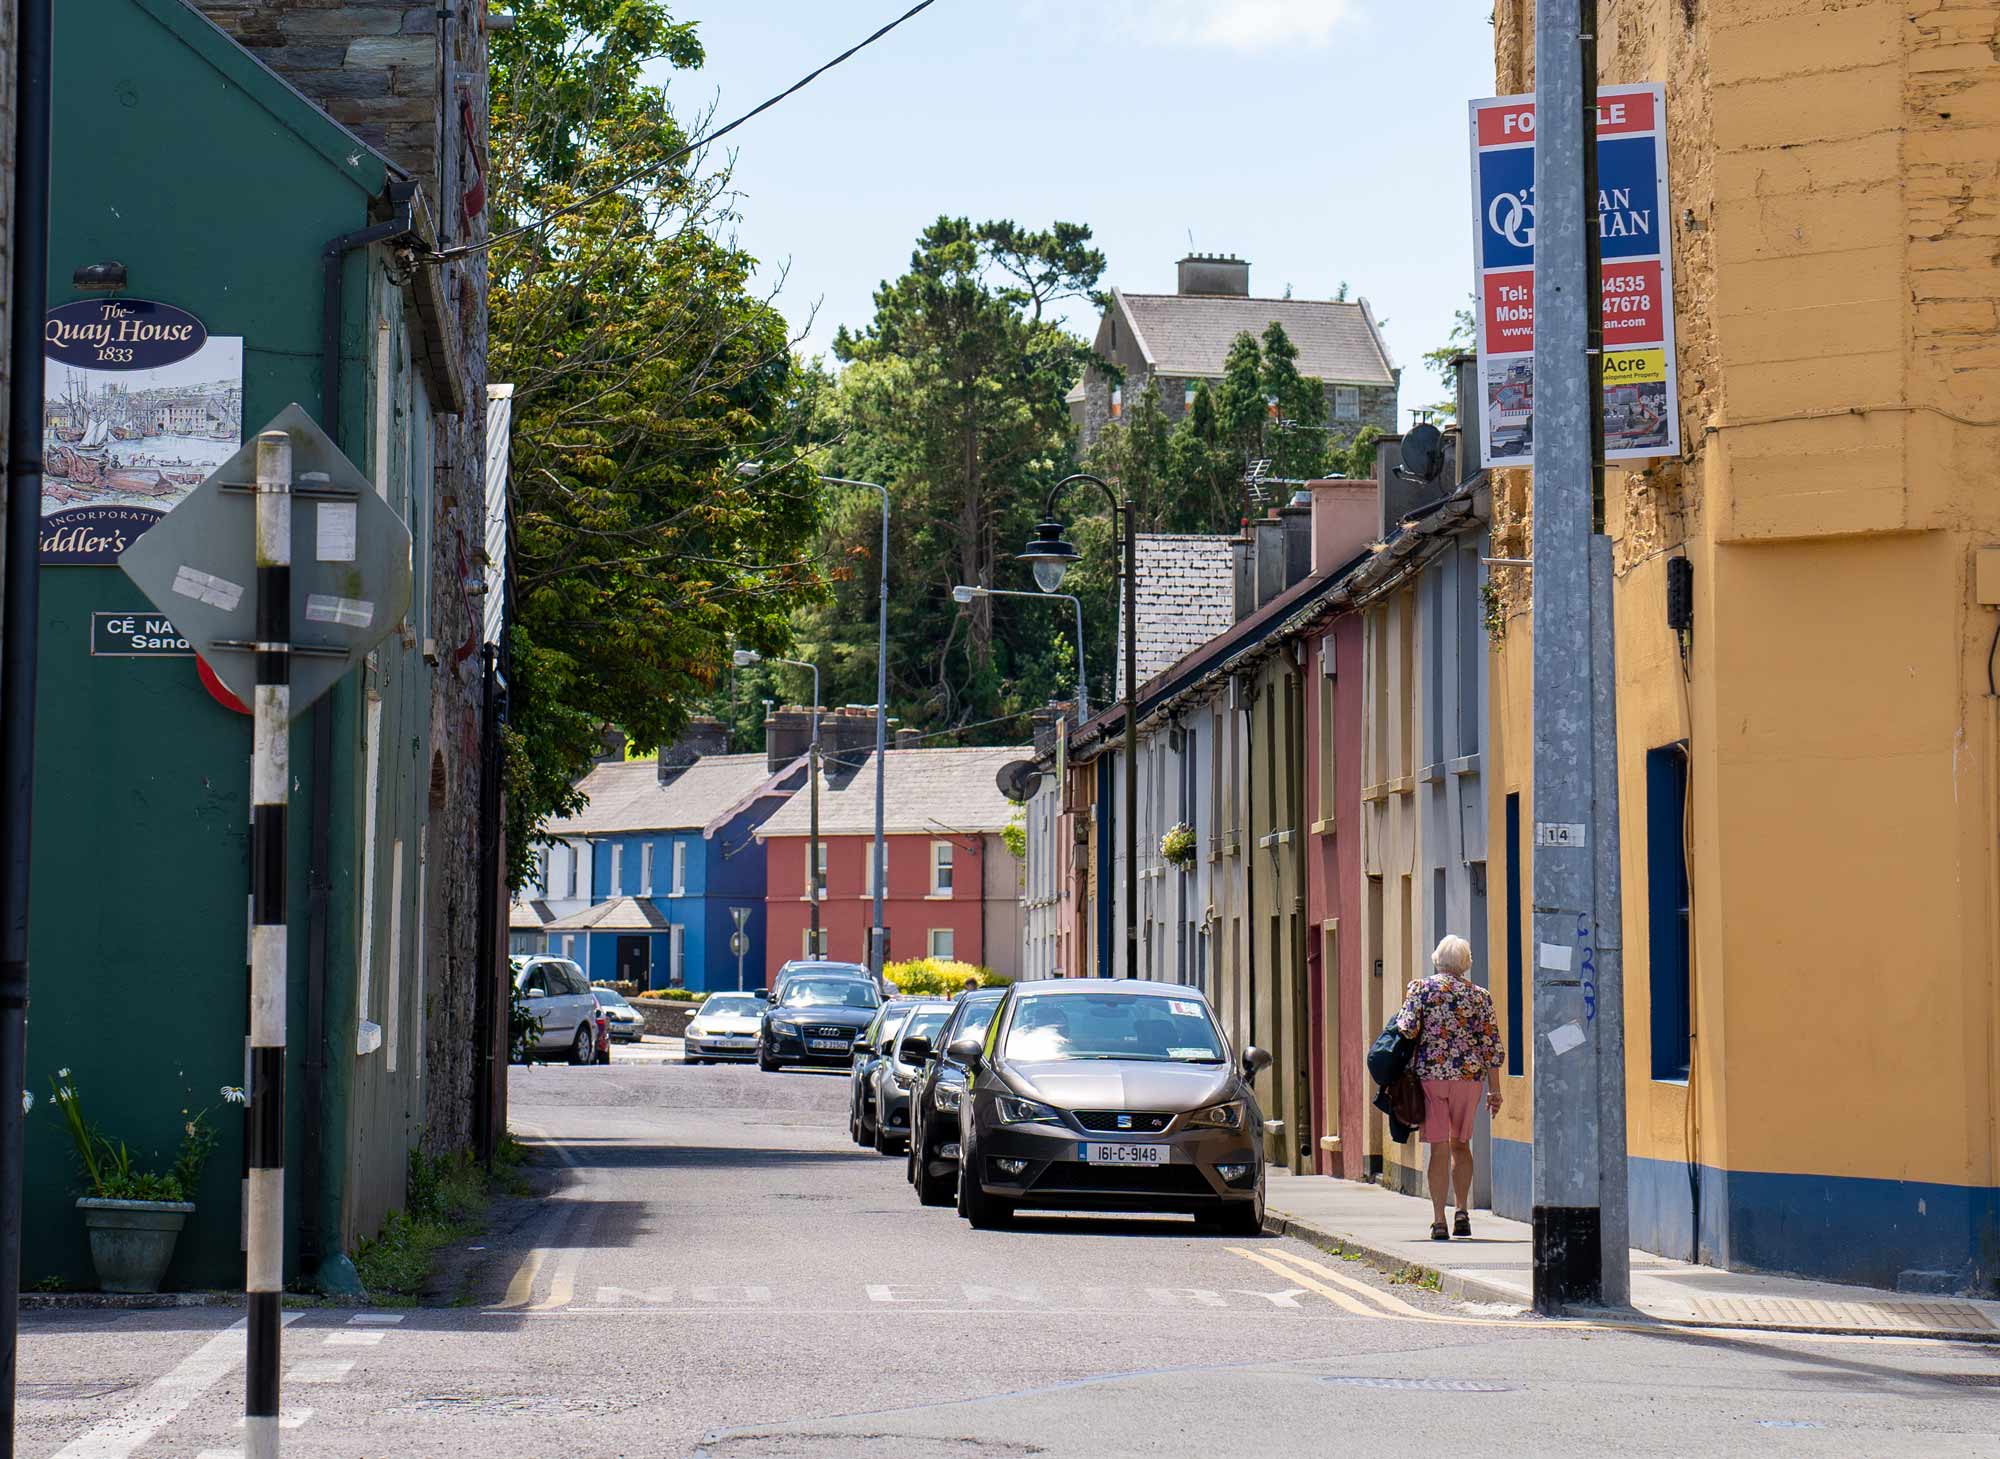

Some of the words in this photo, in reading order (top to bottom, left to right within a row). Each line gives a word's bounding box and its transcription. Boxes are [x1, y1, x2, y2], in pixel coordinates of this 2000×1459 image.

[1503, 112, 1535, 134] FO
[1597, 103, 1626, 126] LE
[1598, 188, 1631, 211] AN
[1499, 286, 1528, 302] Tel:
[1601, 275, 1645, 293] 4535
[100, 303, 135, 321] The
[1496, 305, 1533, 322] Mob:
[1602, 295, 1650, 313] 47678
[45, 319, 111, 348] Quay
[116, 320, 193, 342] House
[1502, 326, 1534, 336] www.
[1603, 317, 1646, 329] an.com
[96, 347, 133, 363] 1833
[1603, 357, 1646, 373] Acre
[40, 526, 127, 552] iddler's
[107, 616, 135, 634] CÉ
[146, 620, 174, 634] NA
[1548, 830, 1568, 841] 14
[1098, 1146, 1157, 1161] 161-C-9148
